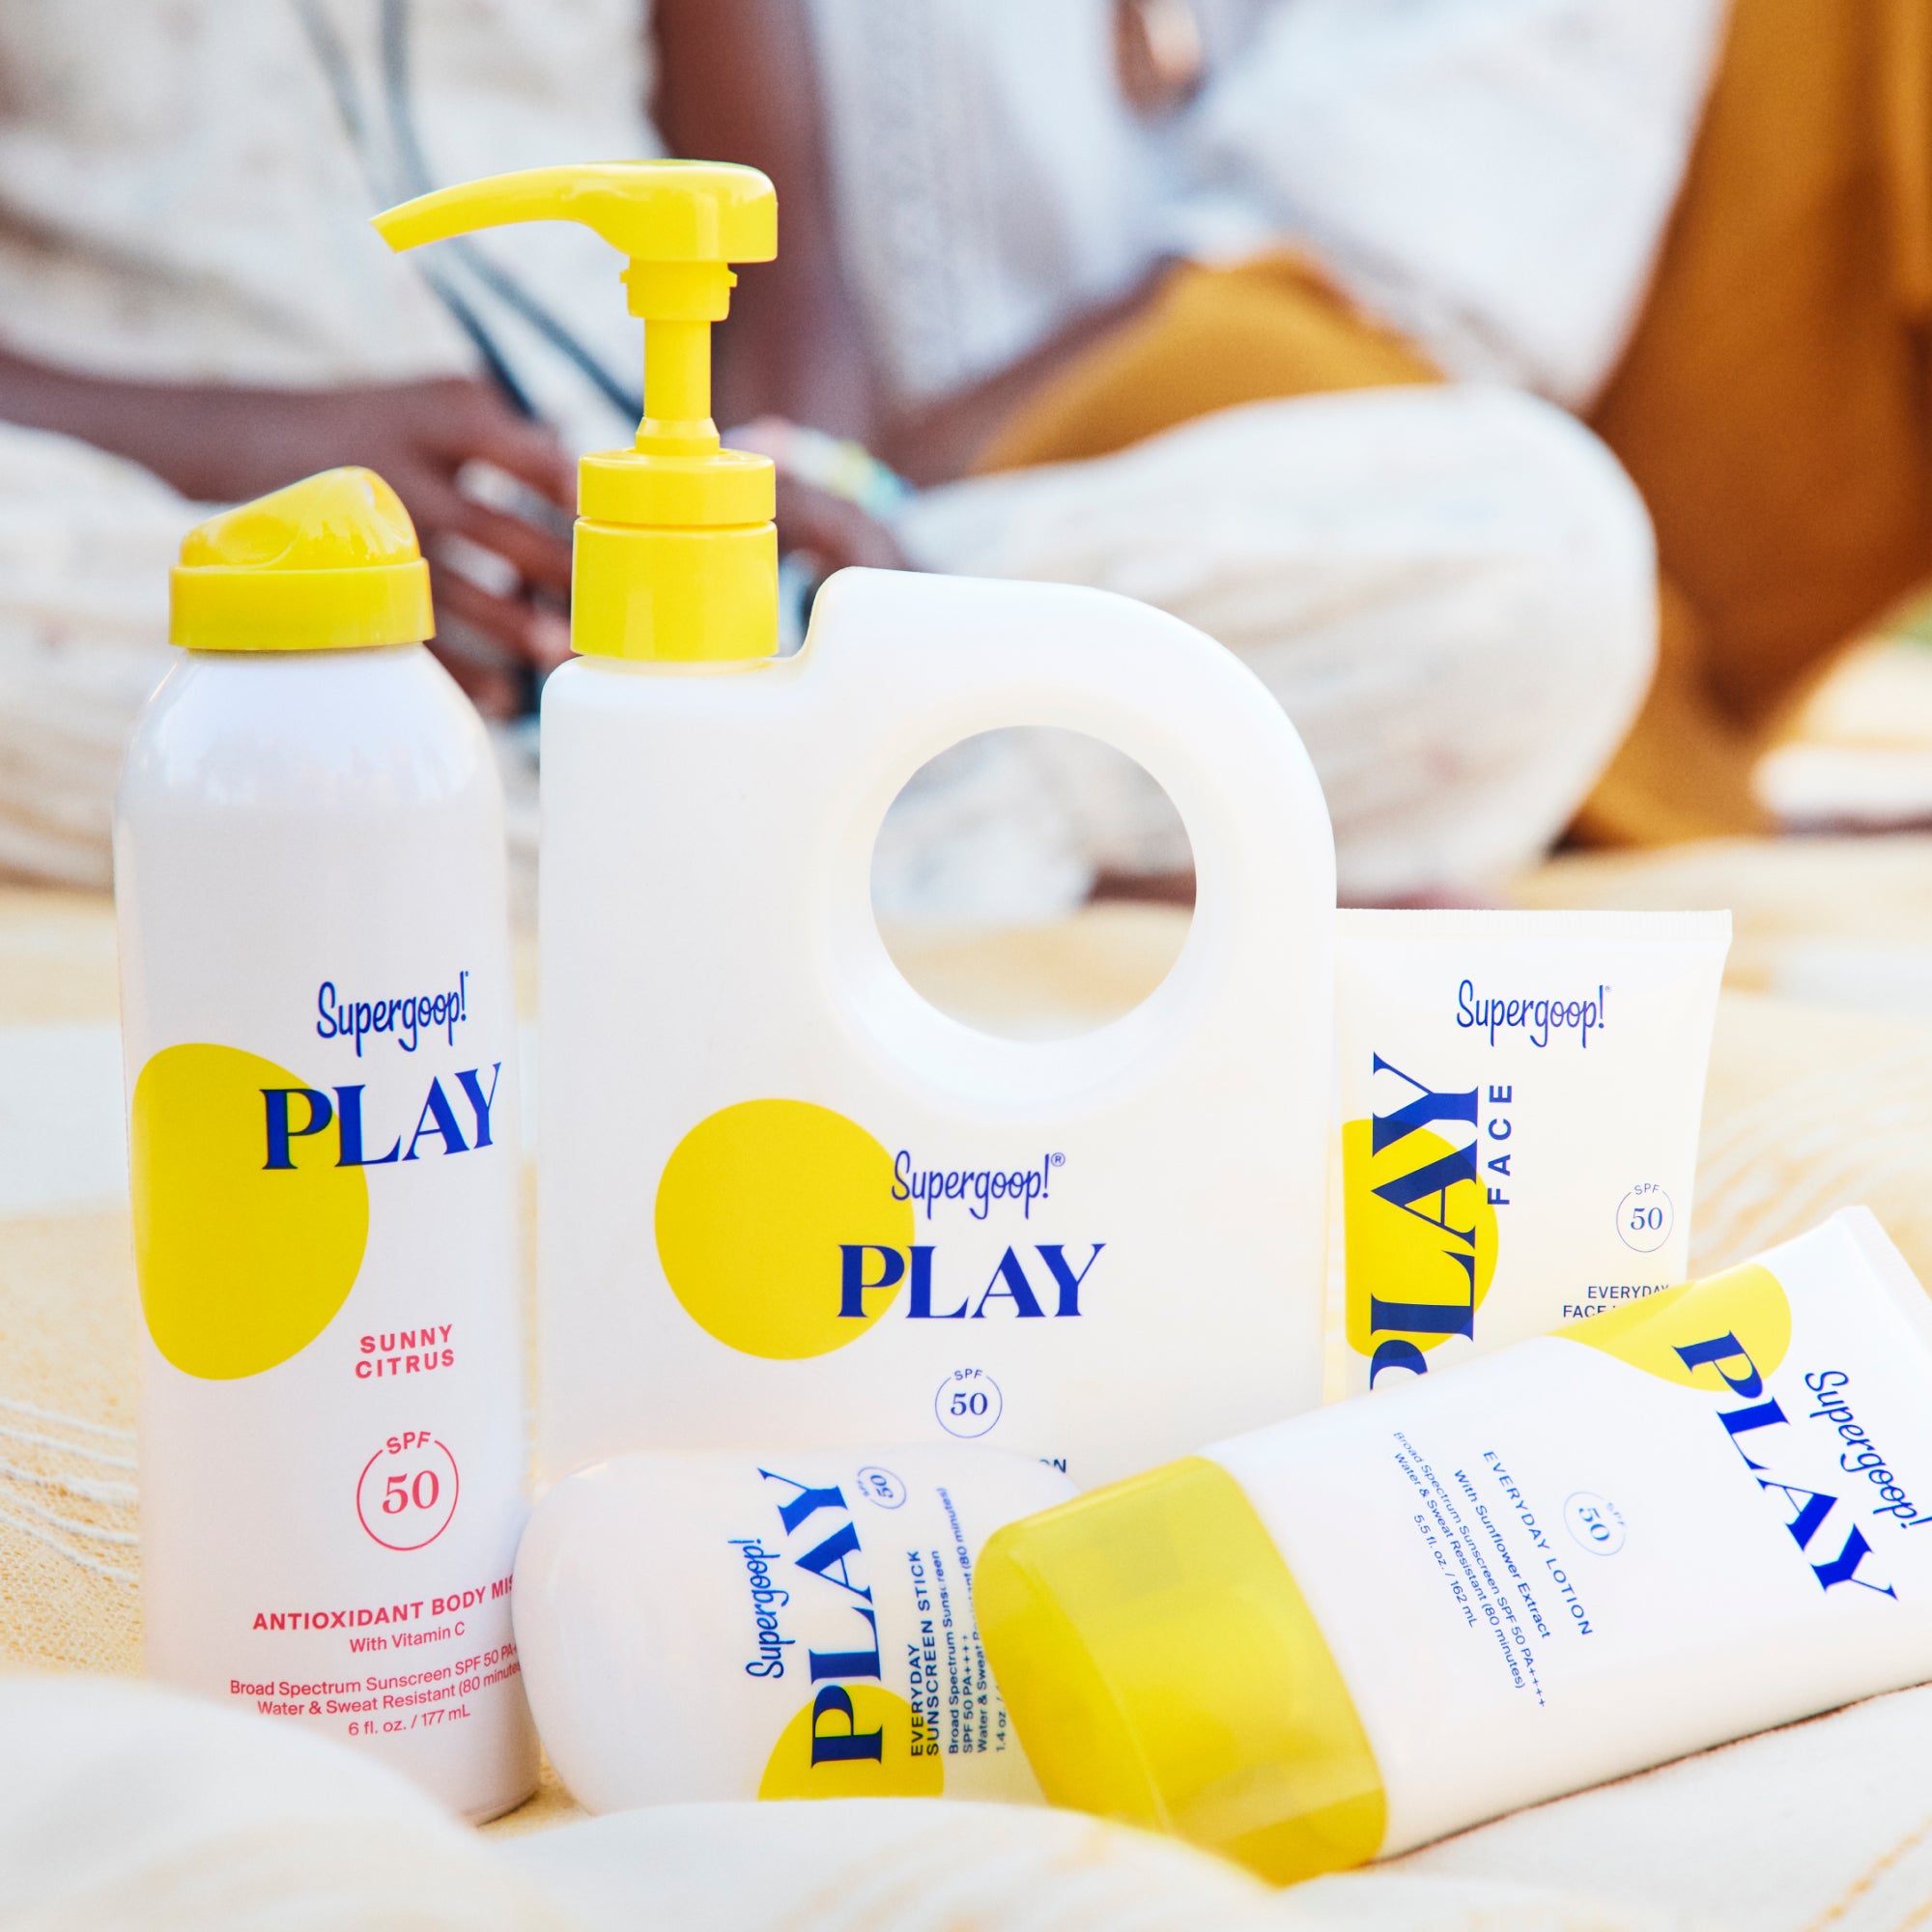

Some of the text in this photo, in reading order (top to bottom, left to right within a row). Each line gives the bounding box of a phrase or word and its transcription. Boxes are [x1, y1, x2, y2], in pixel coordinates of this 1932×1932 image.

[317, 970, 468, 1057] Supergoop!
[259, 1062, 501, 1170] PLAY
[1487, 1084, 1513, 1206] FACE
[1634, 1182, 1661, 1196] SPF
[1630, 1207, 1663, 1231] 50
[837, 1243, 1107, 1319] PLAY
[359, 1323, 454, 1354] SUNNY
[355, 1350, 455, 1379] CITRUS
[953, 1368, 983, 1381] SPF
[950, 1392, 988, 1416] 50
[386, 1431, 432, 1455] SPF
[1671, 1329, 1899, 1601] PLAY
[1804, 1370, 1932, 1529] Supergoop!
[382, 1470, 440, 1514] 50
[870, 1474, 894, 1498] 50
[1484, 1449, 1594, 1636] EVERYDAY LOTION
[1578, 1507, 1610, 1542] 50
[1393, 1431, 1546, 1708] Broad Spectrum Sunscreen SPF 50 PA++++
[1394, 1452, 1526, 1690] Water & Sweat Resistant (80 minutes)
[1413, 1514, 1432, 1535] 5.5
[1426, 1536, 1437, 1548] fl.
[1434, 1550, 1447, 1570] oz.
[1450, 1579, 1468, 1605] 162
[1462, 1605, 1479, 1629] mL
[1454, 1468, 1551, 1639] With Sunflower Extract
[252, 1602, 424, 1631] ANTIOXIDANT
[432, 1586, 486, 1616] BODY
[727, 1539, 796, 1679] Supergoop!
[757, 1467, 883, 1769] PLAY
[349, 1621, 466, 1654] With Vitamin C
[907, 1550, 940, 1756] SUNSCREEN STICK
[230, 1679, 274, 1696] Broad
[278, 1680, 361, 1698] Spectrum
[366, 1666, 451, 1691] Sunscreen
[455, 1655, 482, 1676] SPF
[483, 1649, 499, 1667] 50
[946, 1631, 960, 1706] Spectrum
[257, 1700, 305, 1716] Water
[308, 1700, 322, 1715] &
[326, 1697, 378, 1715] Sweat
[383, 1684, 456, 1709] Resistant
[458, 1676, 481, 1697] (80
[908, 1643, 924, 1757] EVERYDAY
[963, 1699, 974, 1720] 50
[977, 1693, 988, 1706] &
[348, 1703, 470, 1736] 6 fl. oz. / 177 mL
[949, 1709, 959, 1754] Broad
[962, 1724, 974, 1754] SPF
[977, 1709, 988, 1753] Water
